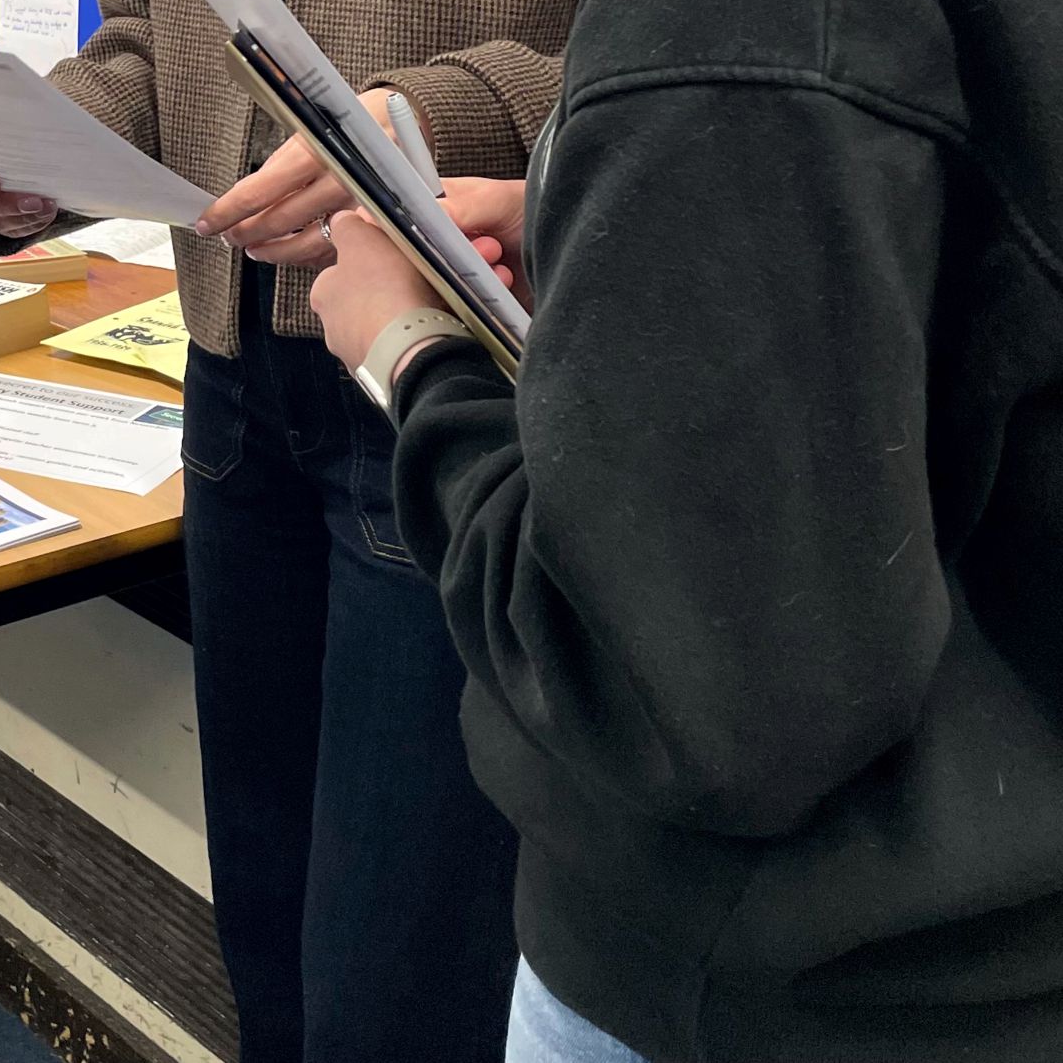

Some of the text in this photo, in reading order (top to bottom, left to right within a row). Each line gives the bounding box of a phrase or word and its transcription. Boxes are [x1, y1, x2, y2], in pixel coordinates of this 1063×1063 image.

[40, 386, 53, 395] to
[56, 389, 82, 399] our
[11, 389, 66, 406] Student
[69, 399, 127, 417] Support
